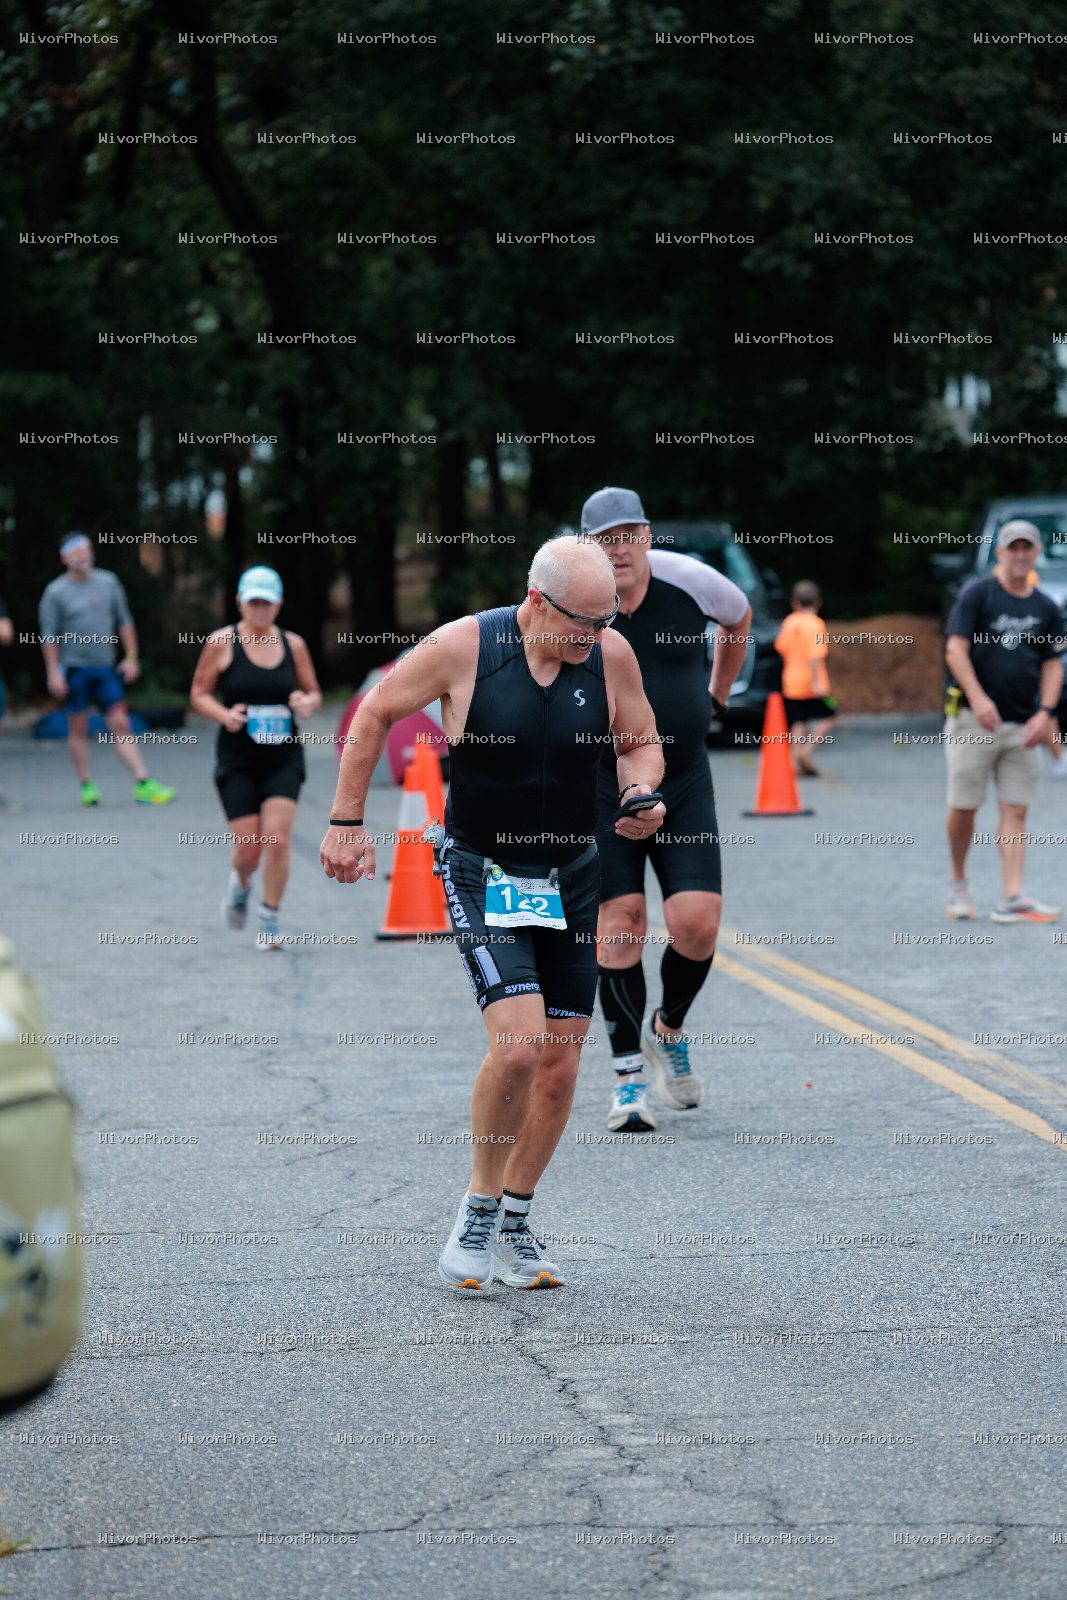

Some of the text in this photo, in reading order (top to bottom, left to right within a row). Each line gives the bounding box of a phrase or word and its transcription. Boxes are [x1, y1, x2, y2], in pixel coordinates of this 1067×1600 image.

[443, 836, 470, 928] snergy
[501, 886, 550, 916] 122
[505, 982, 540, 994] synerg
